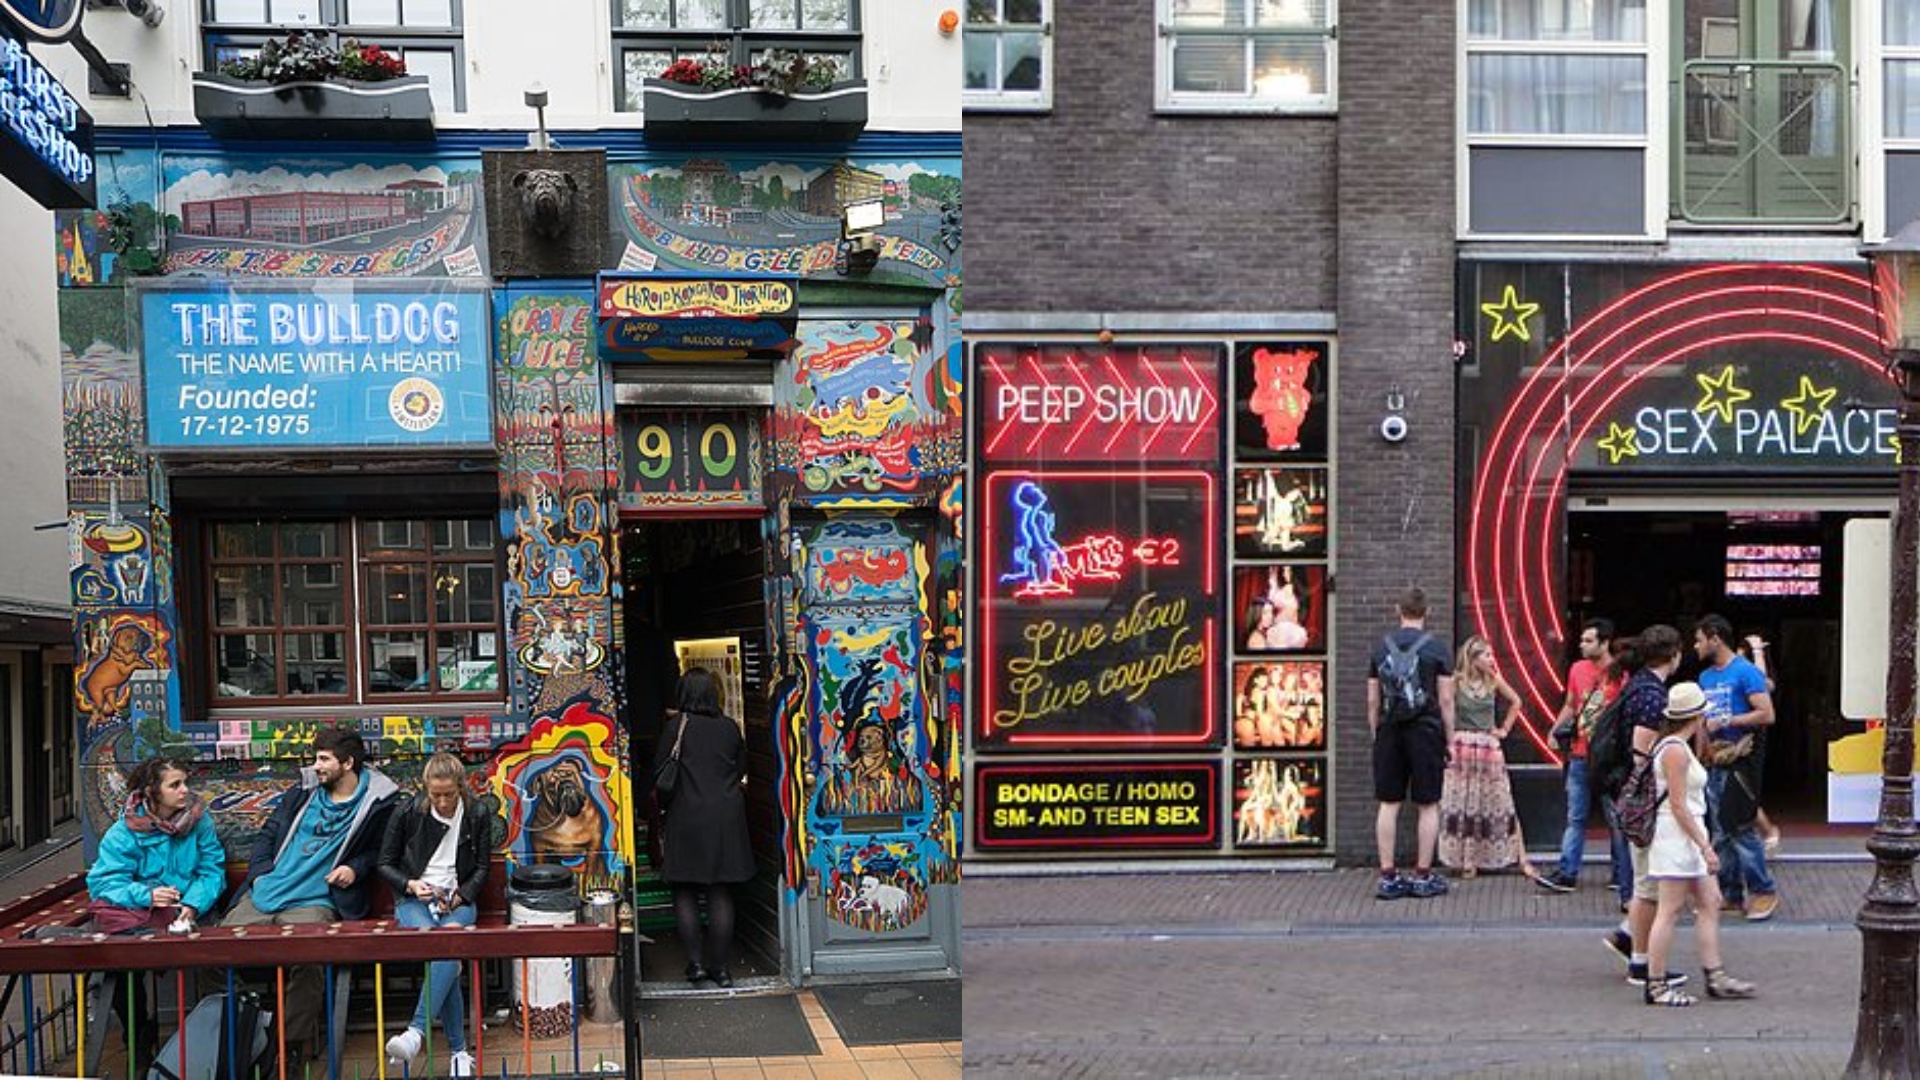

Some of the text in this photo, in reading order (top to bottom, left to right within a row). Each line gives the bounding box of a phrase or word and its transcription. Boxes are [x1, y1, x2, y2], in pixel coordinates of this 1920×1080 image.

[263, 253, 335, 274] BEST
[331, 262, 346, 275] &
[349, 226, 448, 274] BIGGEST
[172, 301, 460, 346] THE BULLDOG
[509, 306, 593, 369] ORANGE JUICE
[682, 335, 724, 346] BULLDOG
[177, 351, 461, 374] THE NAME WITH A HEART!
[178, 384, 318, 410] Founded:
[998, 384, 1204, 424] PEEP SHOW
[181, 414, 310, 436] 17-12-1975
[1635, 406, 1898, 455] SEX PALACE
[1133, 538, 1180, 566] €2
[1007, 590, 1188, 675] Live show
[993, 626, 1206, 728] Live couples
[998, 782, 1195, 803] BONDAGE / HOMO
[993, 806, 1200, 827] SM- AND TEEN SEX
